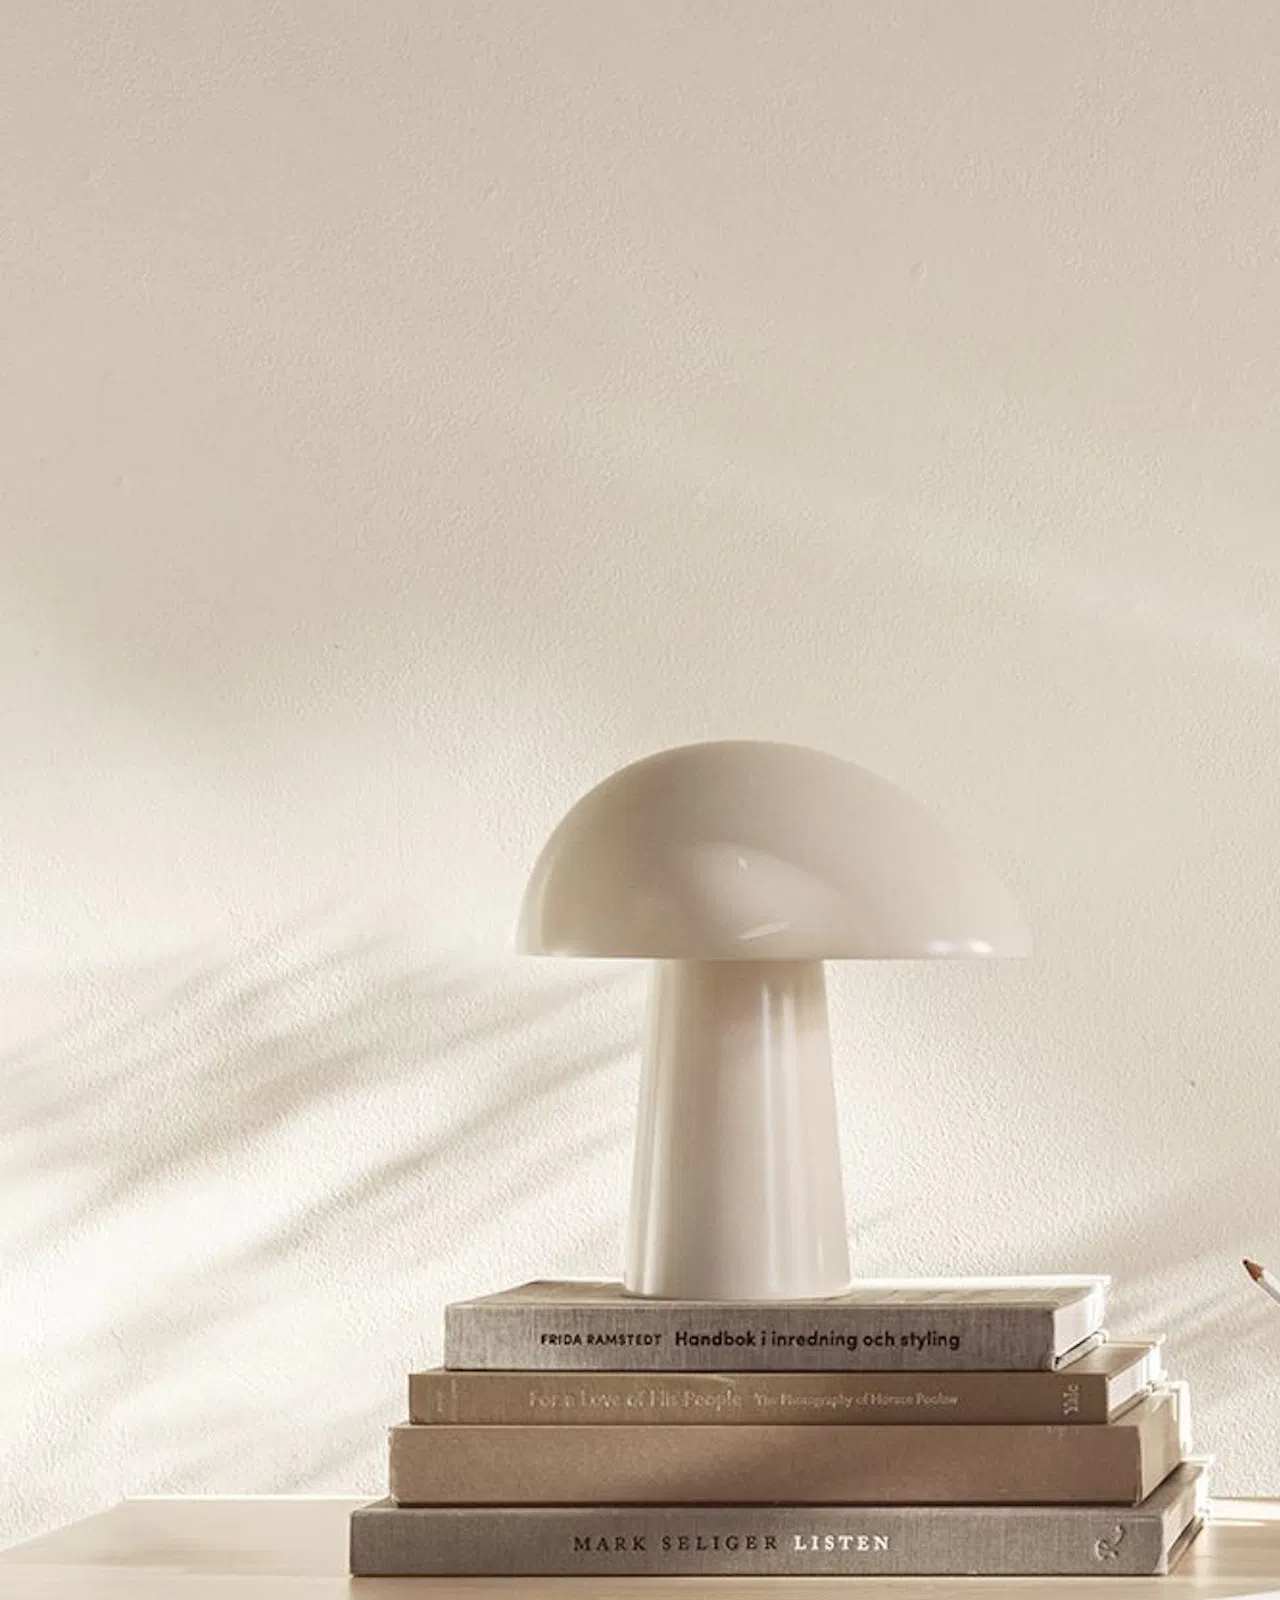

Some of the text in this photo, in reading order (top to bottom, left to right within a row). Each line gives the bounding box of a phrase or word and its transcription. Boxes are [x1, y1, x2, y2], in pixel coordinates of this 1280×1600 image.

[540, 1333, 662, 1347] FRIDA RAMSTEDT
[675, 1330, 961, 1352] Handbok i inredning och styling
[573, 1534, 890, 1552] MARK SELIGER LISTEN
